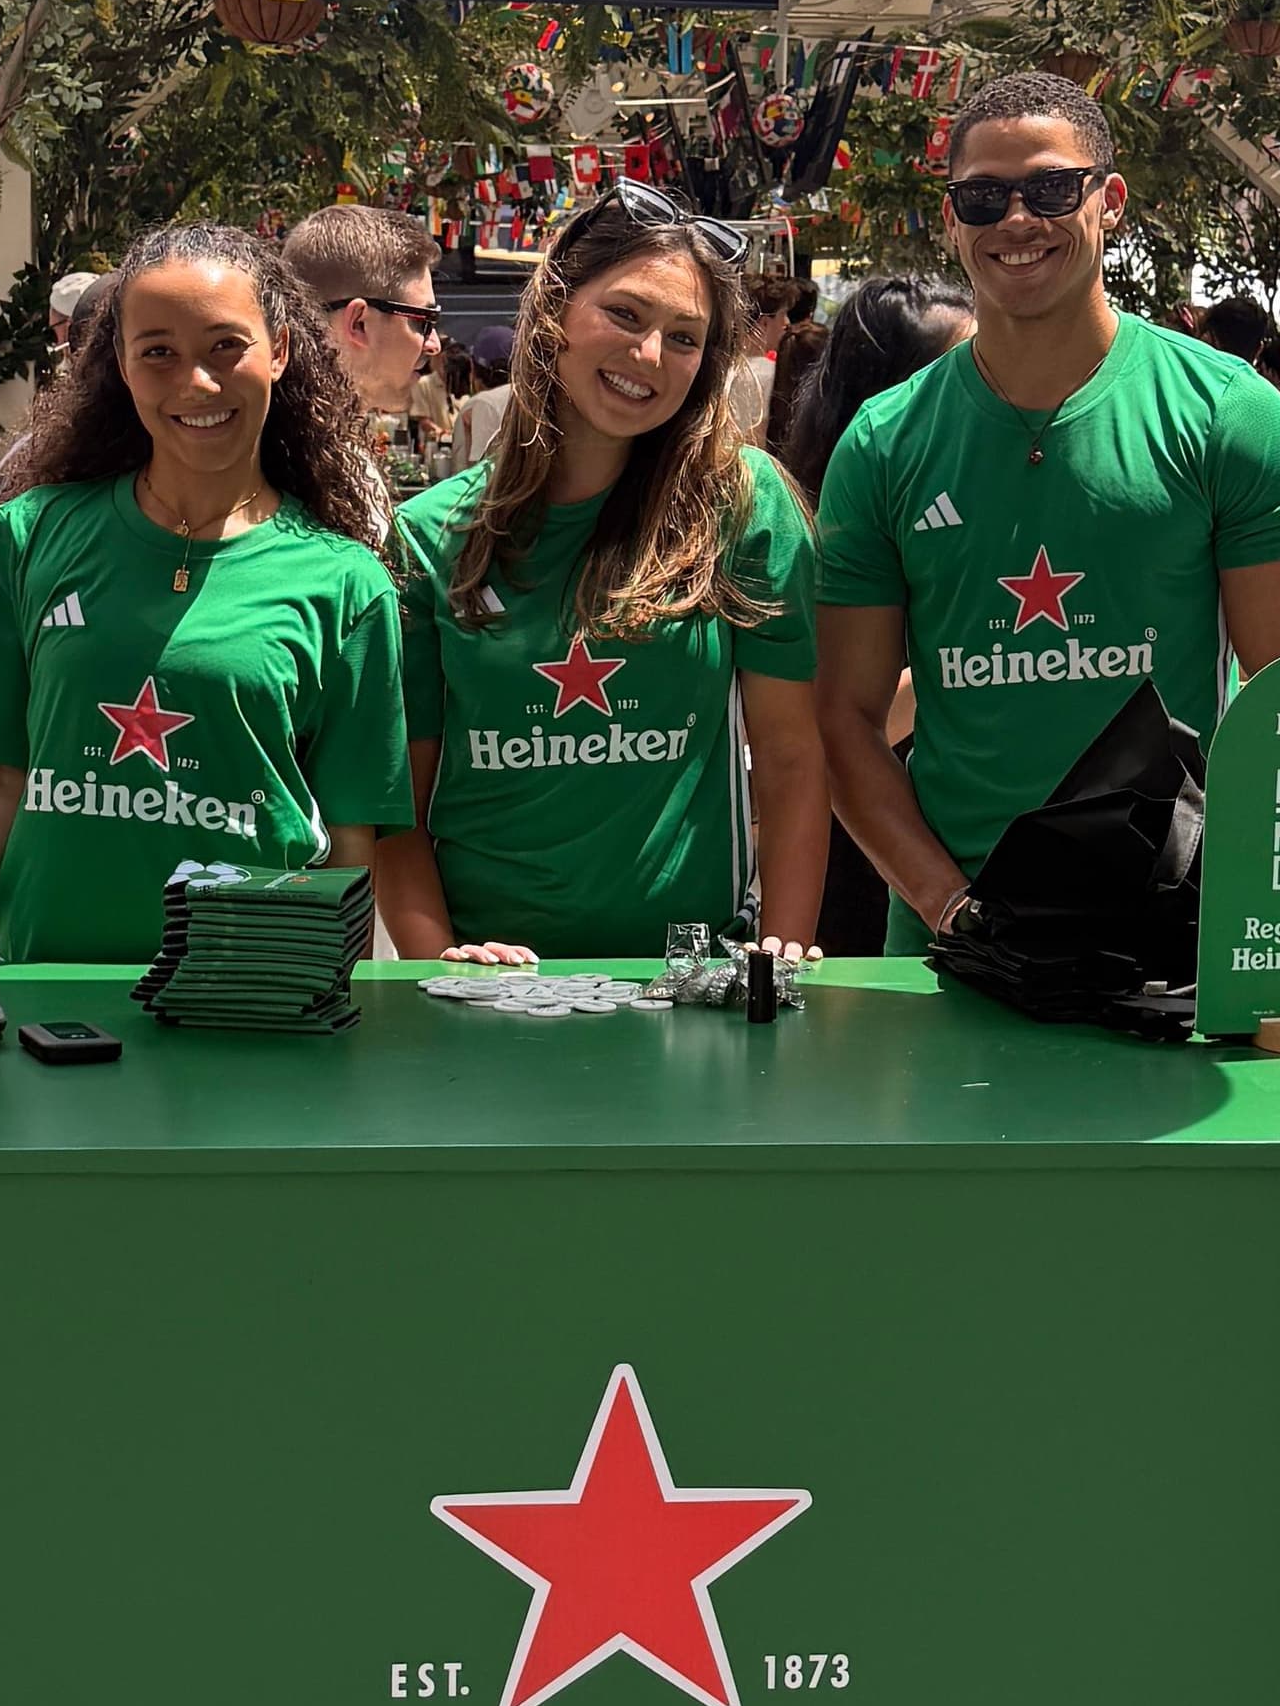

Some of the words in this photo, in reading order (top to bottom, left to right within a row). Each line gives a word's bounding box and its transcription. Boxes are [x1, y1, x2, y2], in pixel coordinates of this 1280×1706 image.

[988, 619, 1010, 629] EST.
[1073, 614, 1095, 625] 1873
[526, 704, 548, 714] EST.
[617, 699, 639, 710] 1873
[83, 746, 106, 757] EST.
[176, 757, 200, 770] 1873
[390, 1660, 471, 1699] EST.
[763, 1653, 851, 1691] 1873
